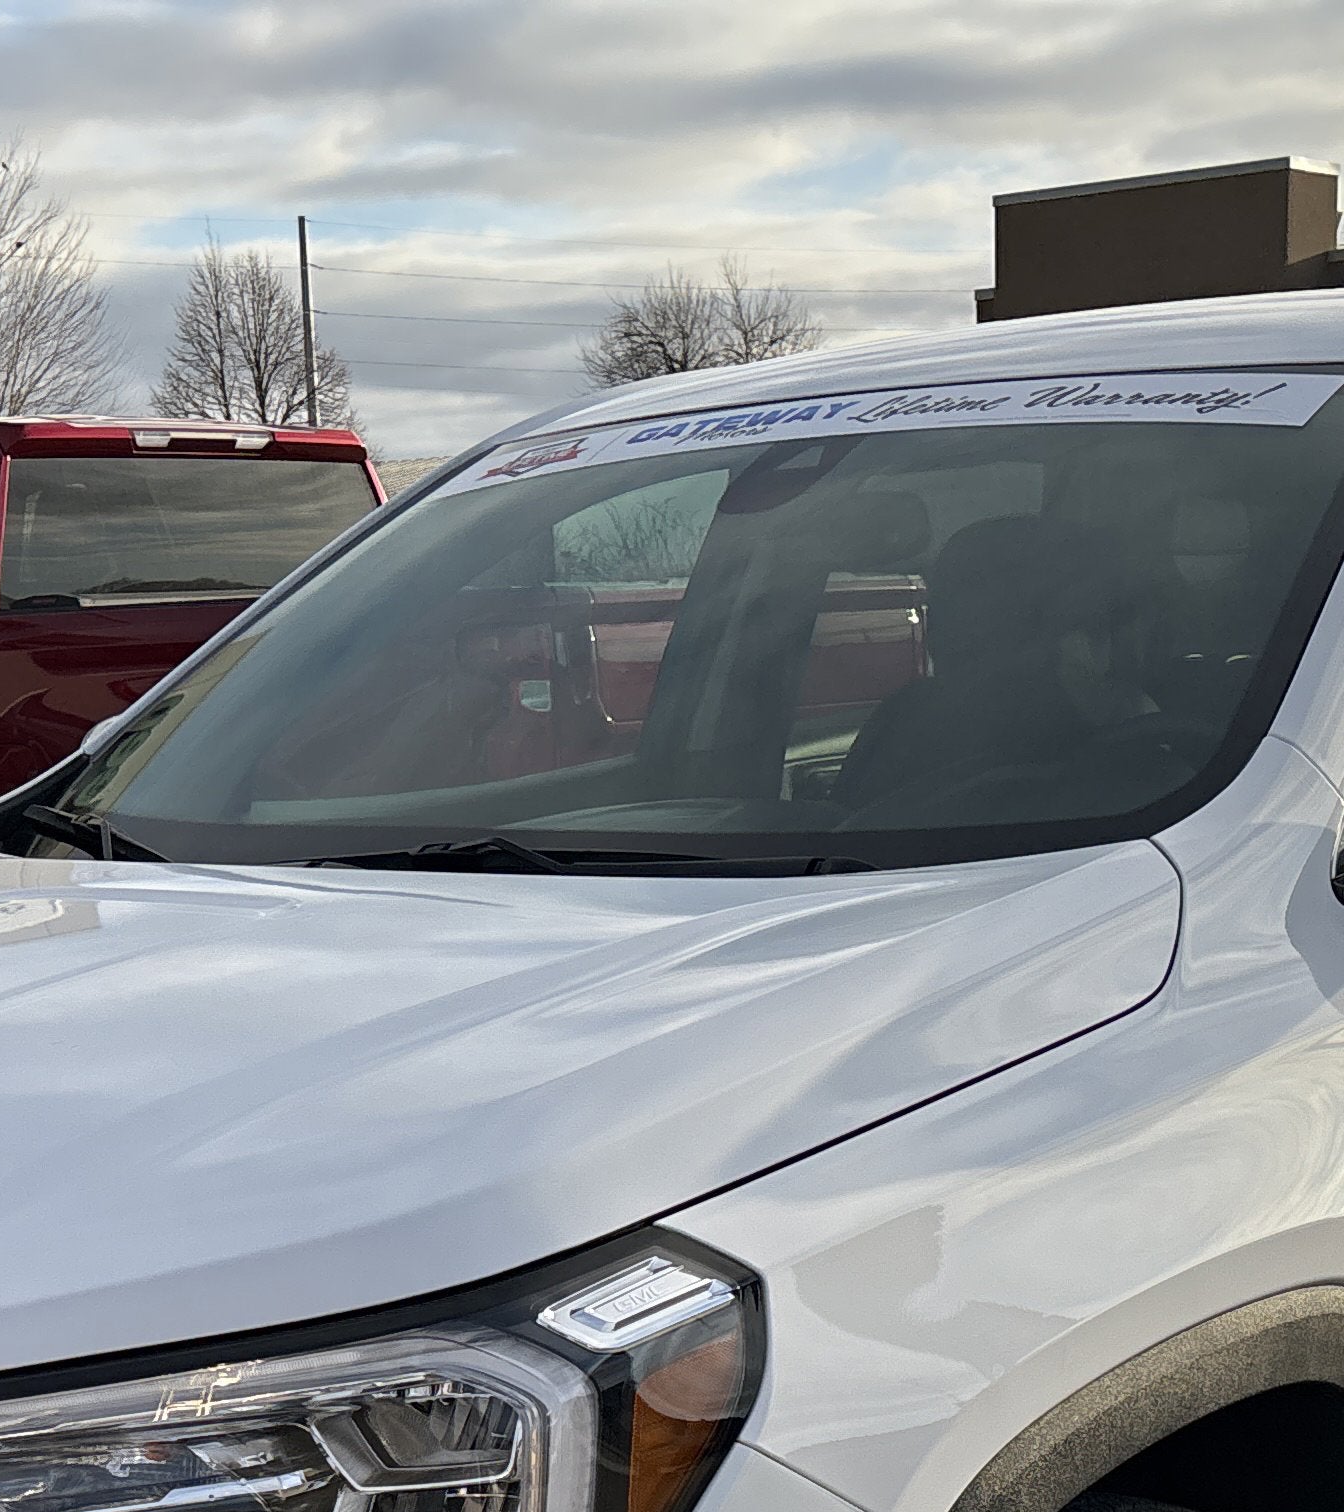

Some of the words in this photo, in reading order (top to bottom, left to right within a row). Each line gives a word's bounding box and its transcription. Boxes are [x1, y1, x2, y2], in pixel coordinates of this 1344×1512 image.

[626, 400, 860, 445] GATEWAY
[847, 393, 1011, 423] Lifetime
[1019, 381, 1288, 414] Warranty!
